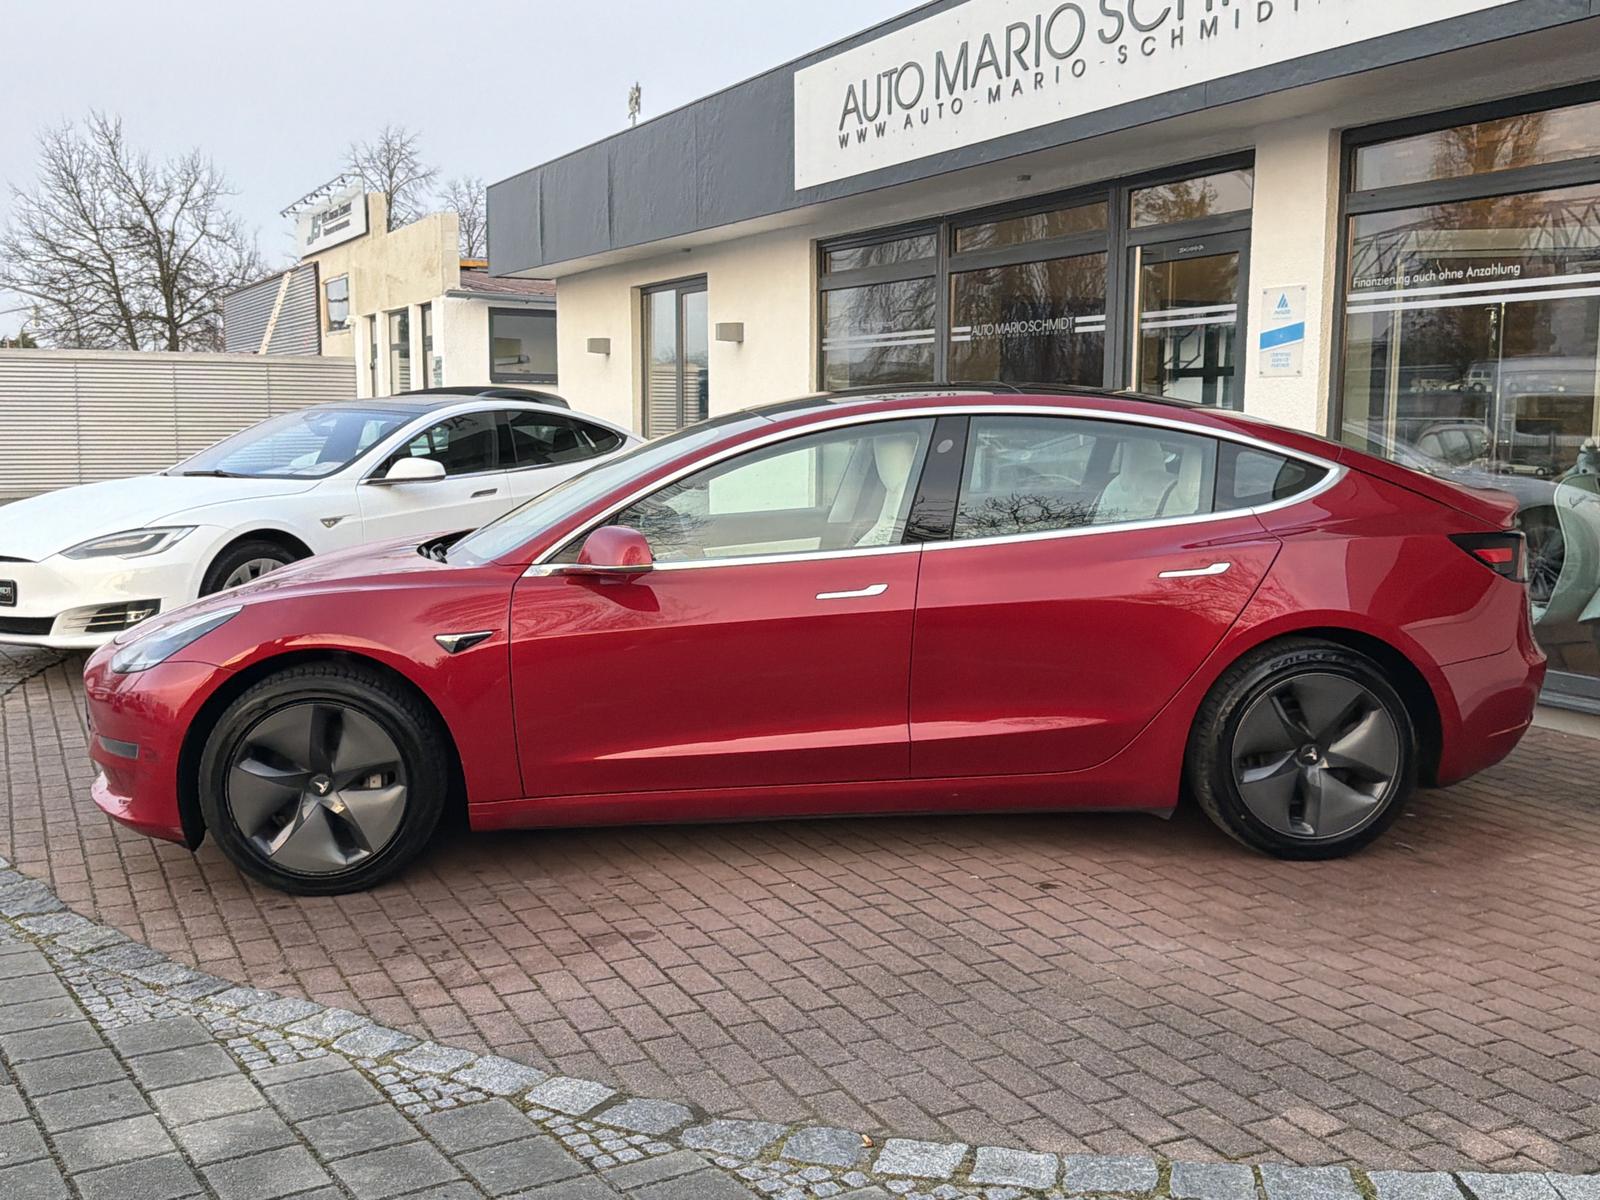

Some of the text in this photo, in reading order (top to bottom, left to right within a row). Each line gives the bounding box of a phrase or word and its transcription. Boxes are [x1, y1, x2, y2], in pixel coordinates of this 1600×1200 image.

[839, 0, 1229, 131] AUTO MARIO SC
[1352, 263, 1521, 288] Finanzierung auch ohne Anzahlung
[971, 317, 1074, 336] AUTO MARIO SCHMIDT
